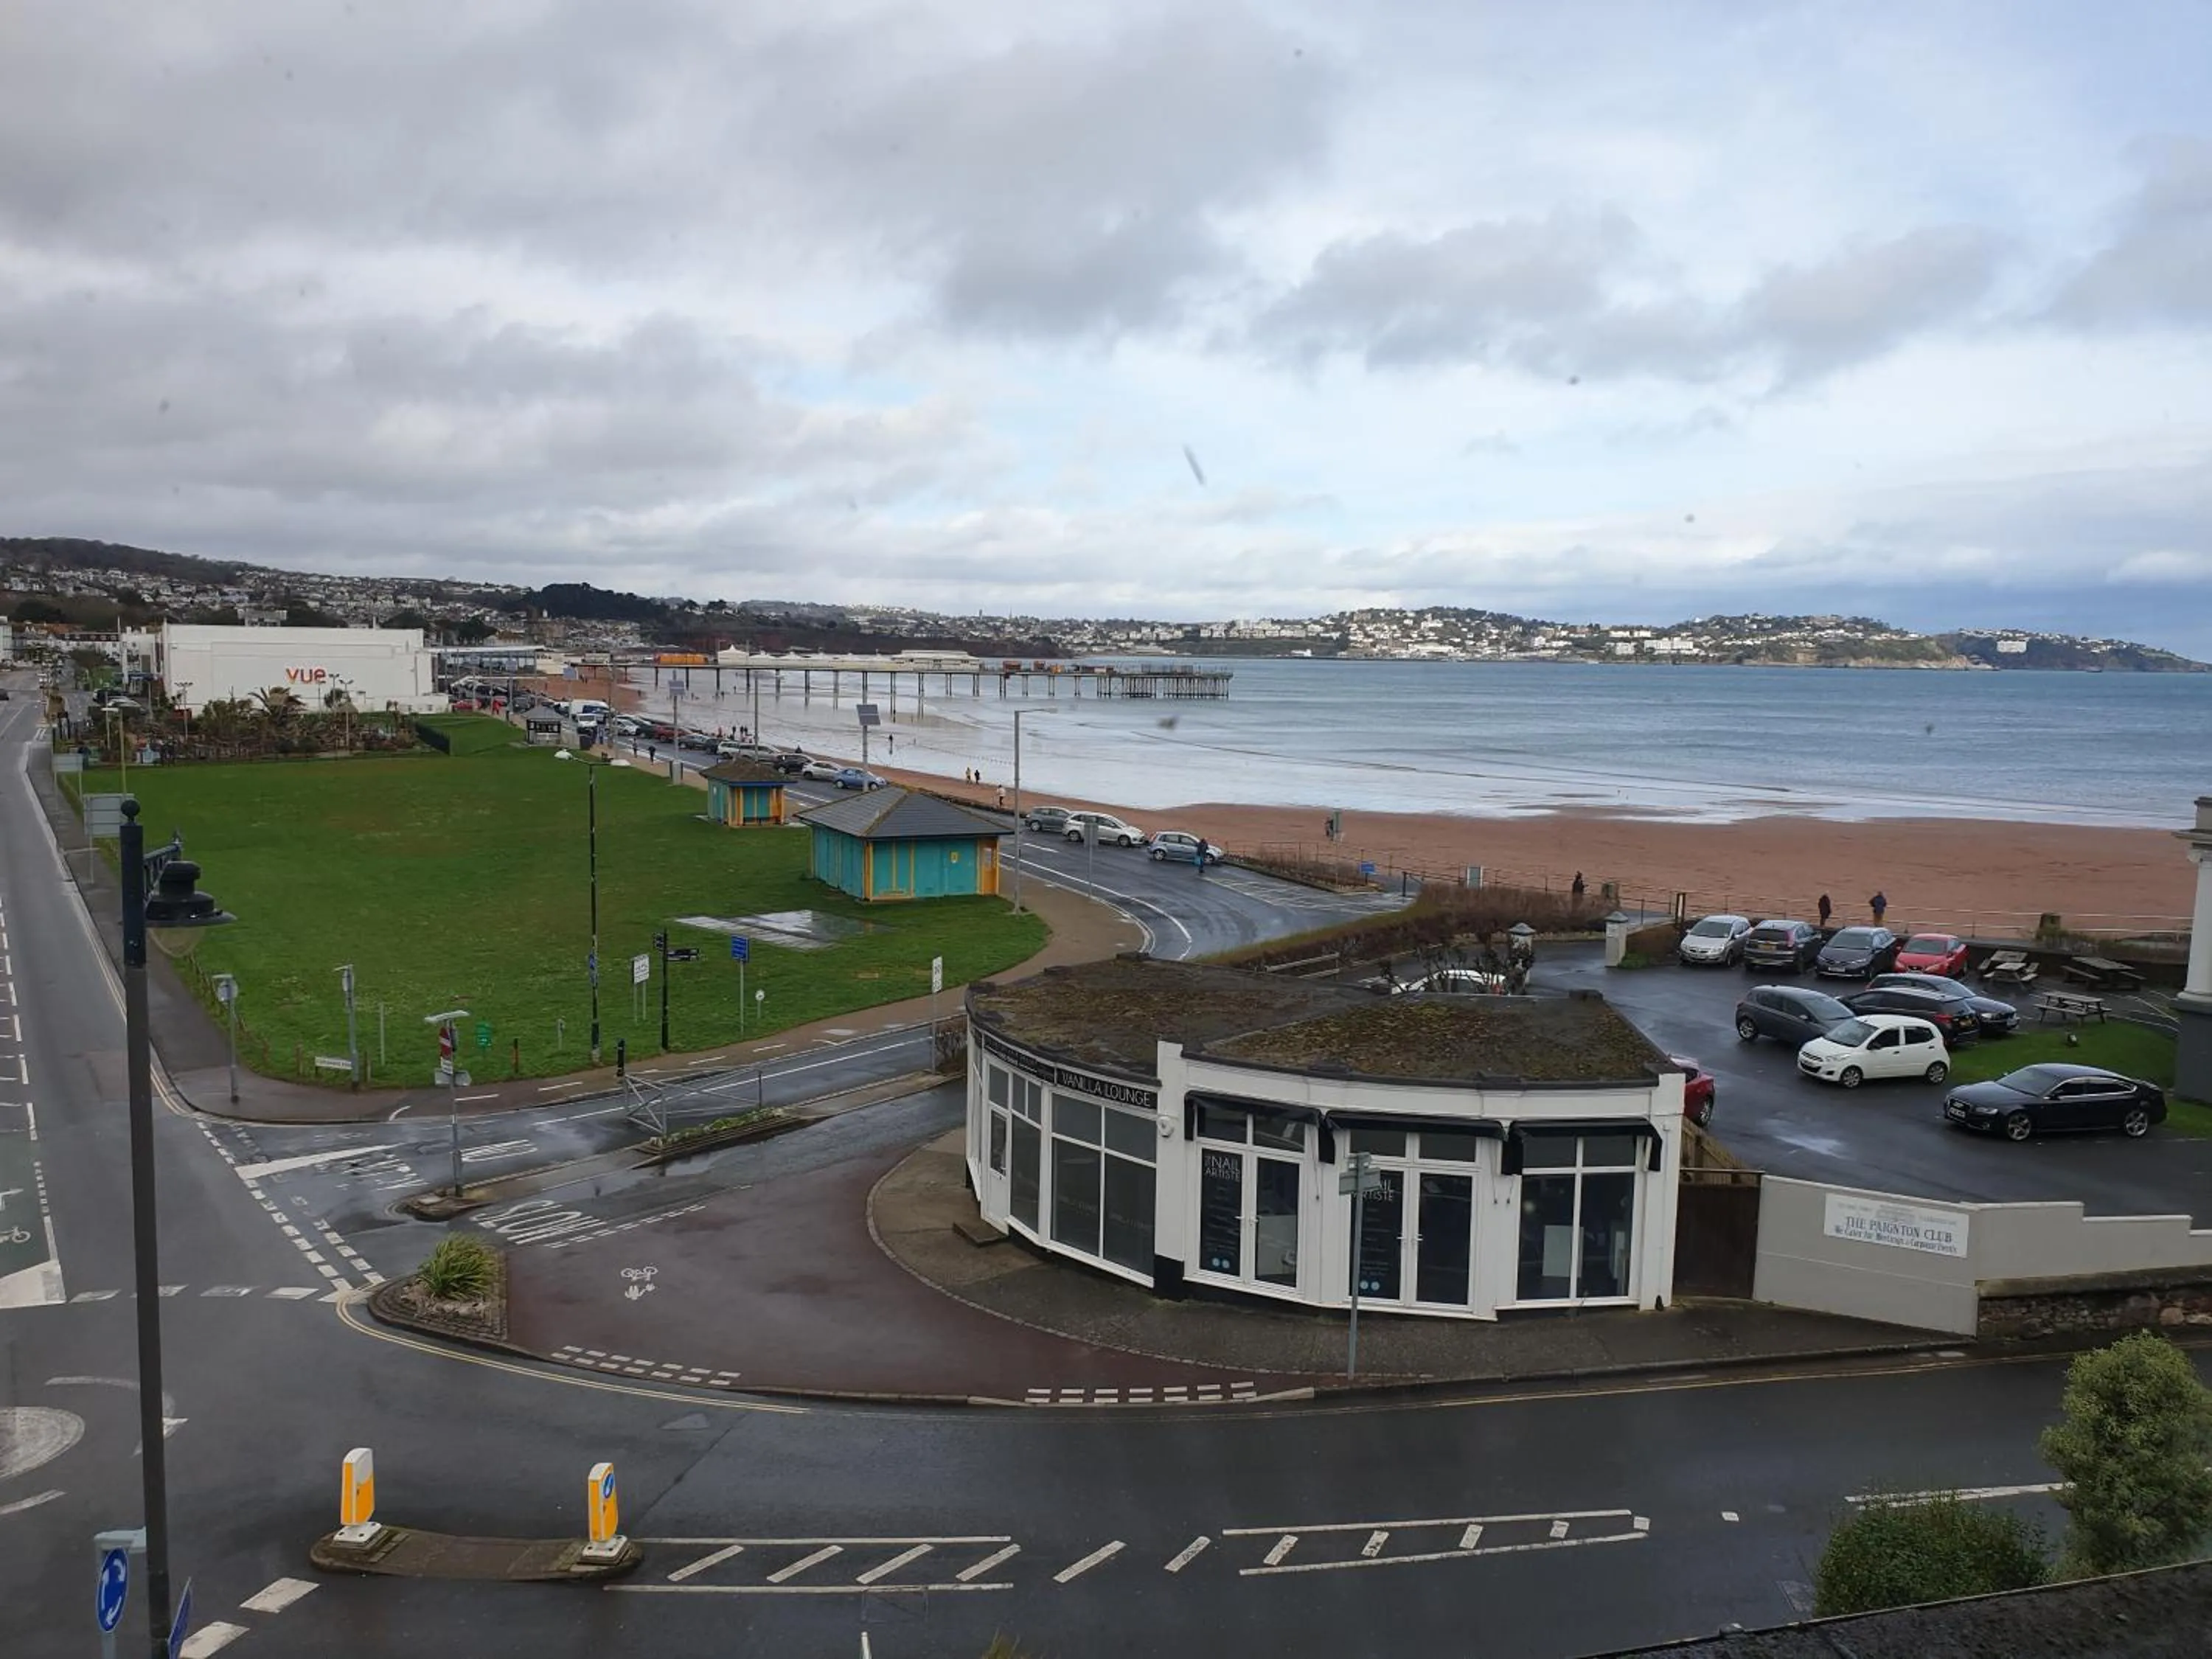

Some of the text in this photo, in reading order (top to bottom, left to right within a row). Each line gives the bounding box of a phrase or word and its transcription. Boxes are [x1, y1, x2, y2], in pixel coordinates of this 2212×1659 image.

[1062, 1071, 1150, 1107] VANILLA LOUNGE
[1206, 1167, 1240, 1182] ARTISTE
[1211, 1155, 1239, 1169] NAIL
[469, 1200, 608, 1245] SLOW
[1846, 1216, 1865, 1230] THE
[1869, 1219, 1920, 1238] PAIGNTON
[1923, 1228, 1952, 1242] CLUB
